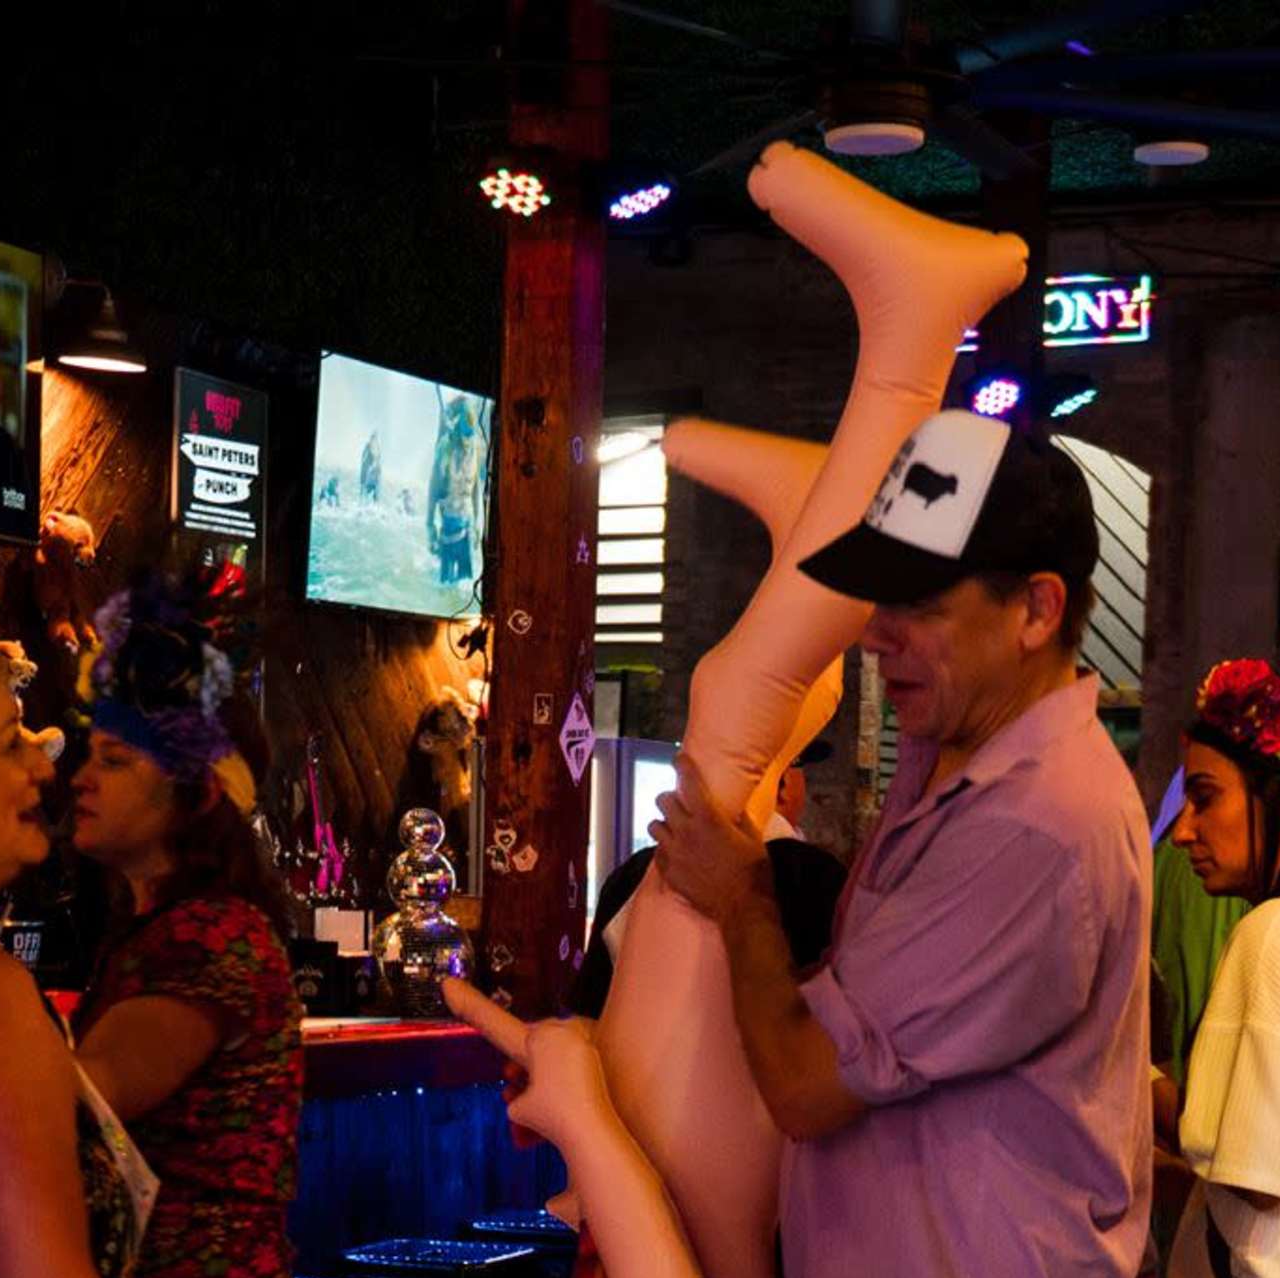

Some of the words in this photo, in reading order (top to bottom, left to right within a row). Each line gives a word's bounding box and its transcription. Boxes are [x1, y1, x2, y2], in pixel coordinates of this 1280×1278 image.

[1043, 288, 1141, 333] ONY
[192, 442, 219, 460] SAINT
[221, 447, 255, 467] PETERS
[205, 479, 238, 496] PUNCH
